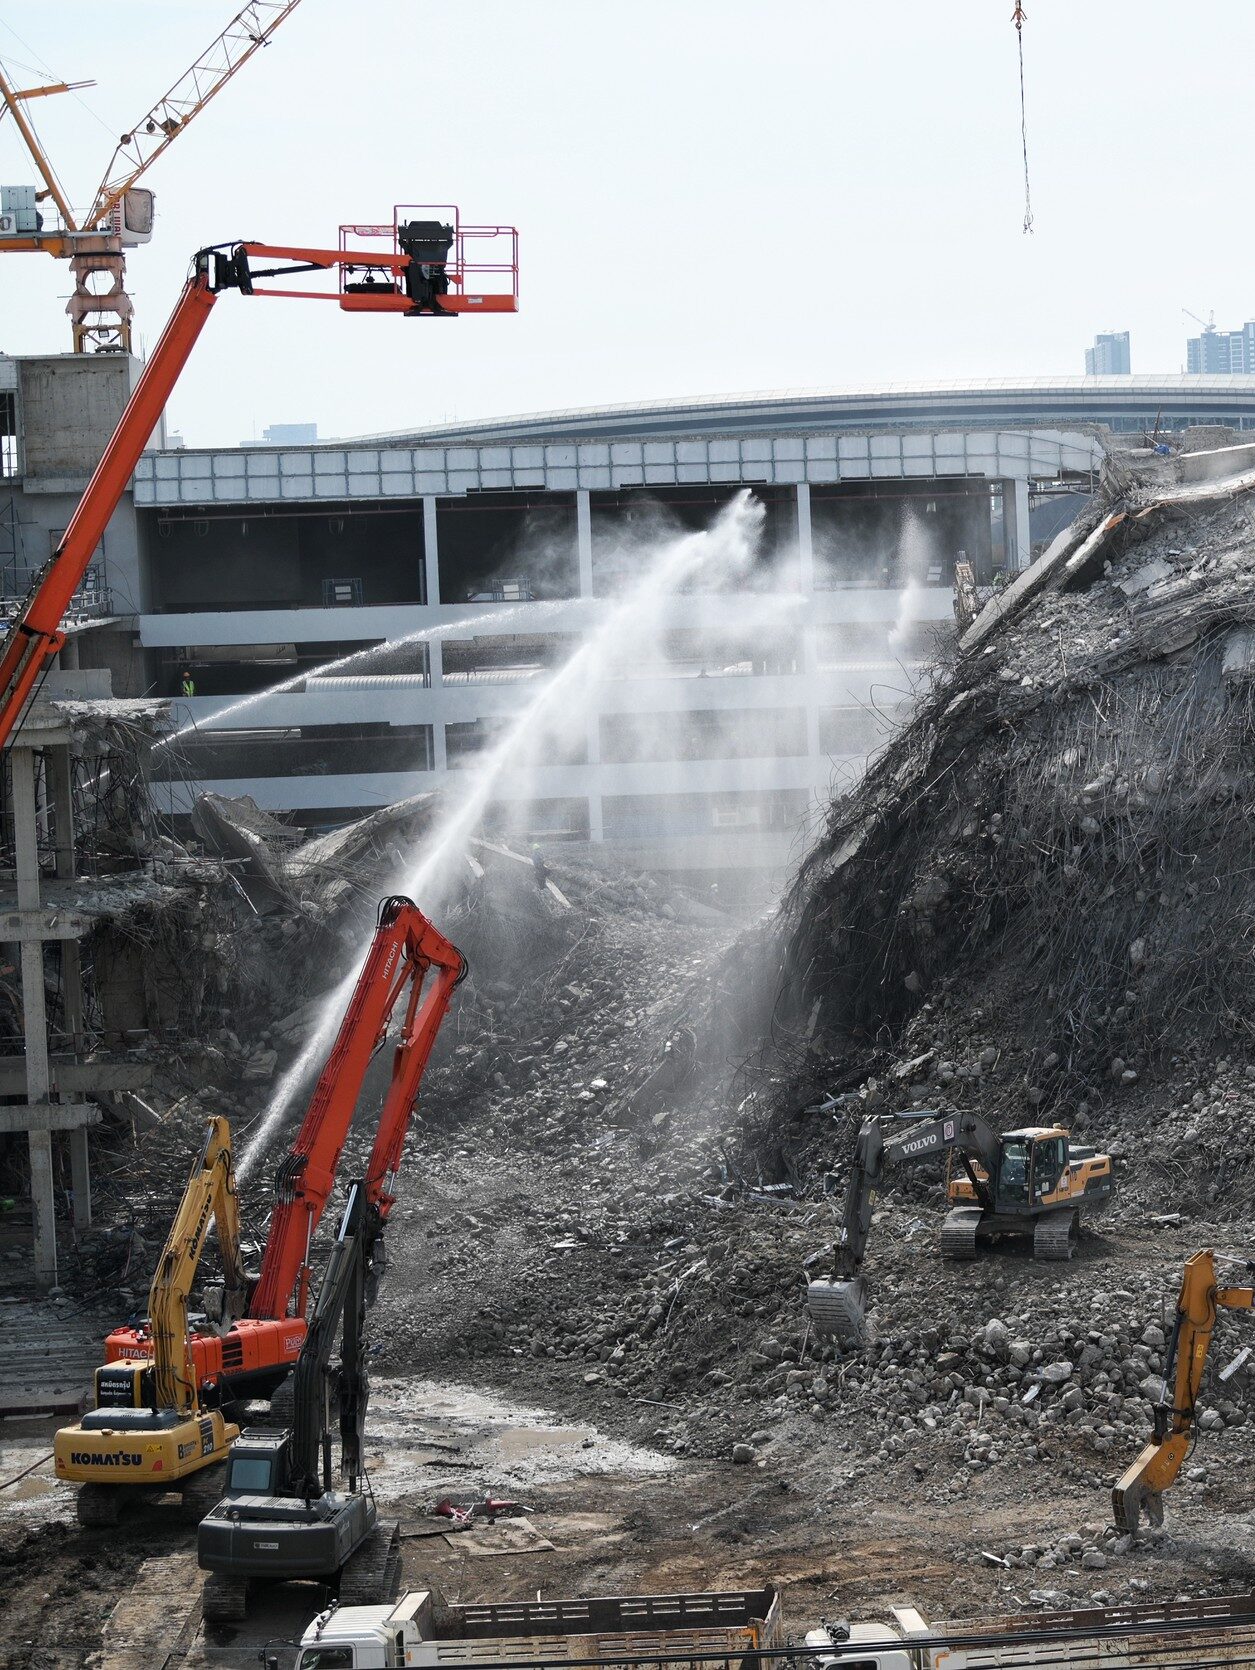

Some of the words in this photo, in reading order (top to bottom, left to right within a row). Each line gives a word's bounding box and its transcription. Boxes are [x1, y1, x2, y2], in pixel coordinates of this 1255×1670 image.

[382, 941, 399, 980] HITACHI
[902, 1134, 937, 1154] VOLVO
[189, 1193, 212, 1261] KOMATSU
[118, 1347, 155, 1361] HITACH
[71, 1451, 142, 1466] KOMATSU
